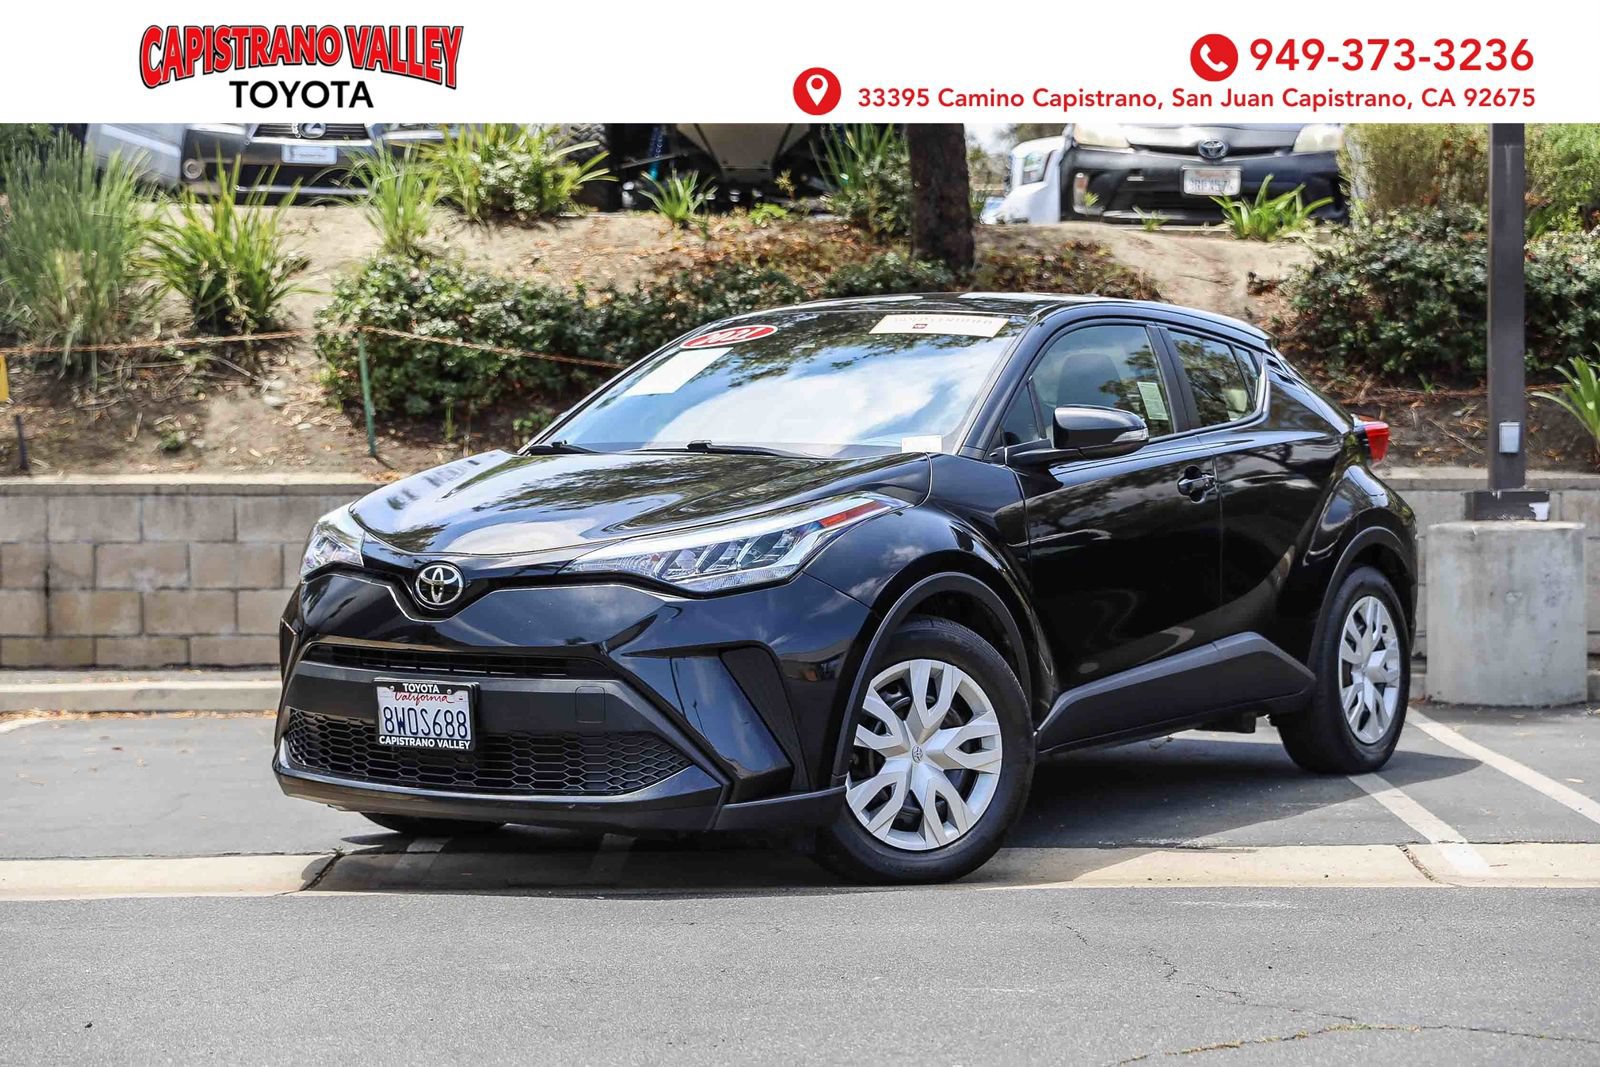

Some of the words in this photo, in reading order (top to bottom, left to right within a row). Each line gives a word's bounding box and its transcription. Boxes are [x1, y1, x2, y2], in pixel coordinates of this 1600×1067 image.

[402, 683, 440, 694] TOYOTA
[379, 735, 435, 748] CAPISTRANO
[437, 739, 470, 750] VALLEY
